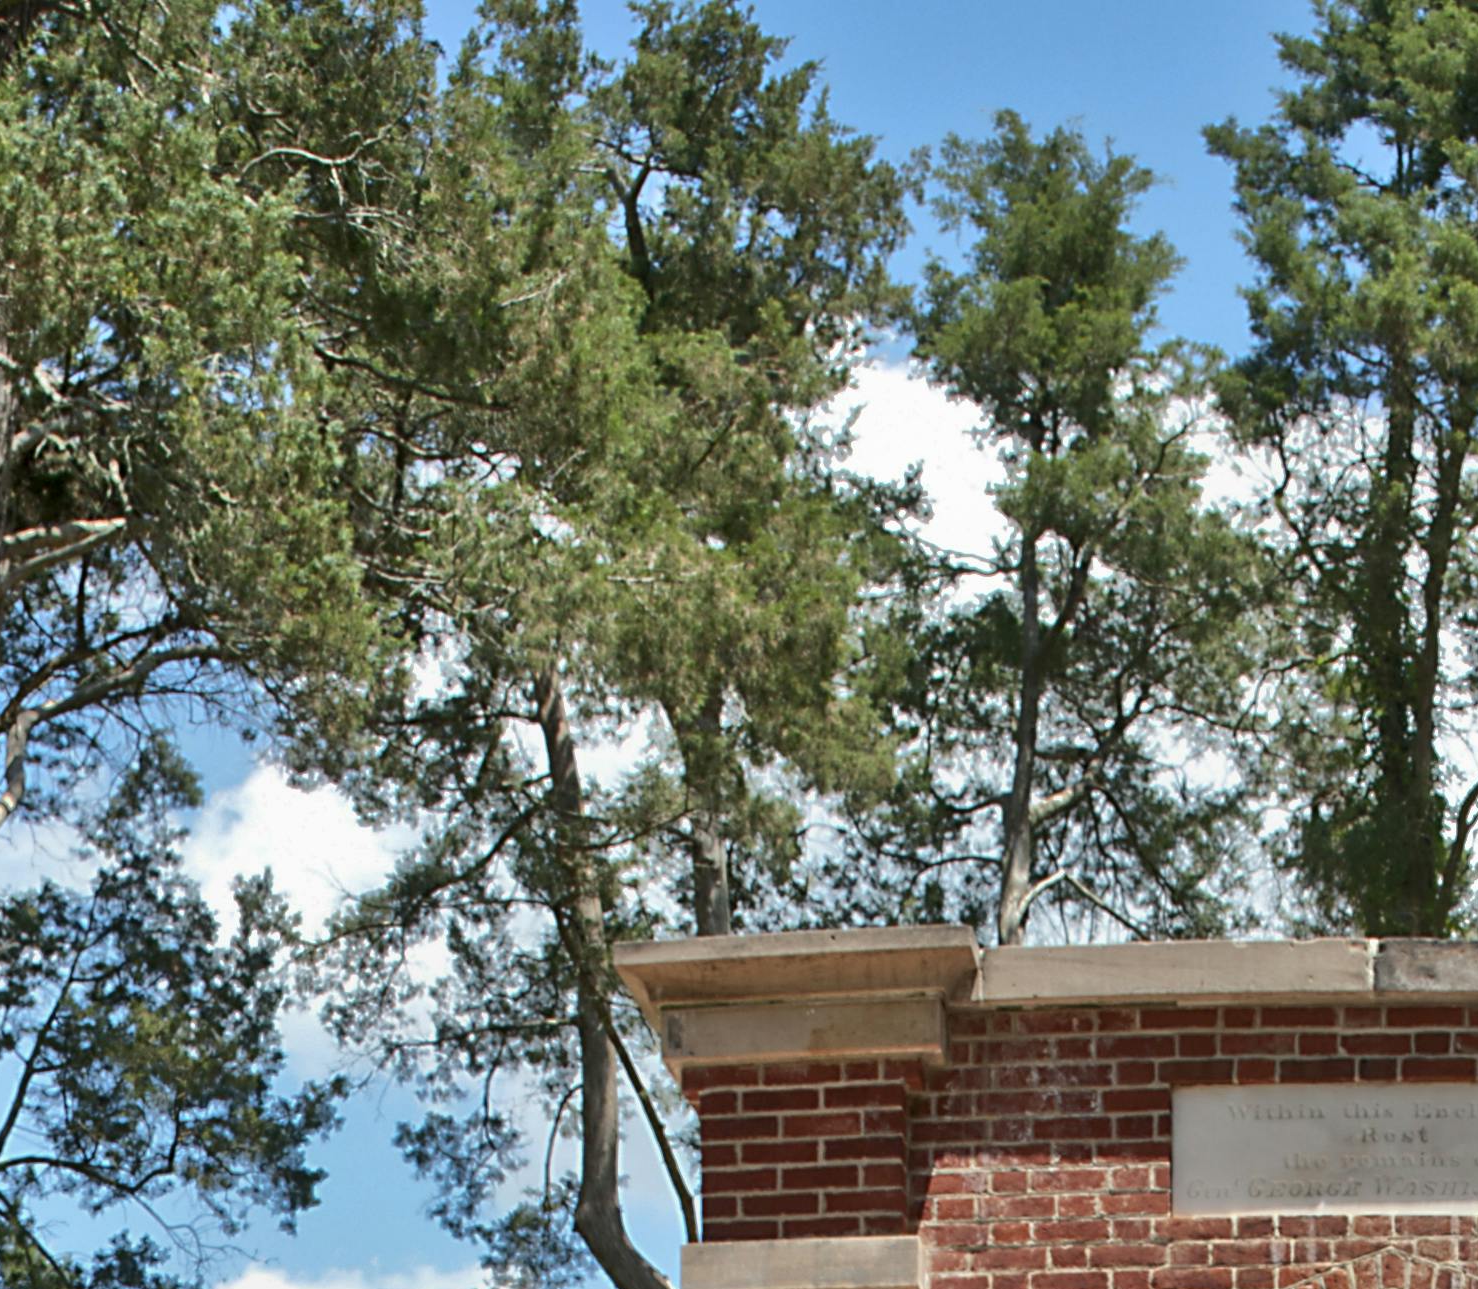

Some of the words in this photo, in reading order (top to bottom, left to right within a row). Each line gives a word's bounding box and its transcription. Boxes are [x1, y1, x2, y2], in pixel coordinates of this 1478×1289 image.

[1227, 1102, 1326, 1121] Within
[1343, 1102, 1394, 1120] this
[1360, 1126, 1430, 1145] Rest
[1282, 1153, 1328, 1170] the
[1339, 1152, 1461, 1170] remains
[1246, 1177, 1363, 1199] GEORGE
